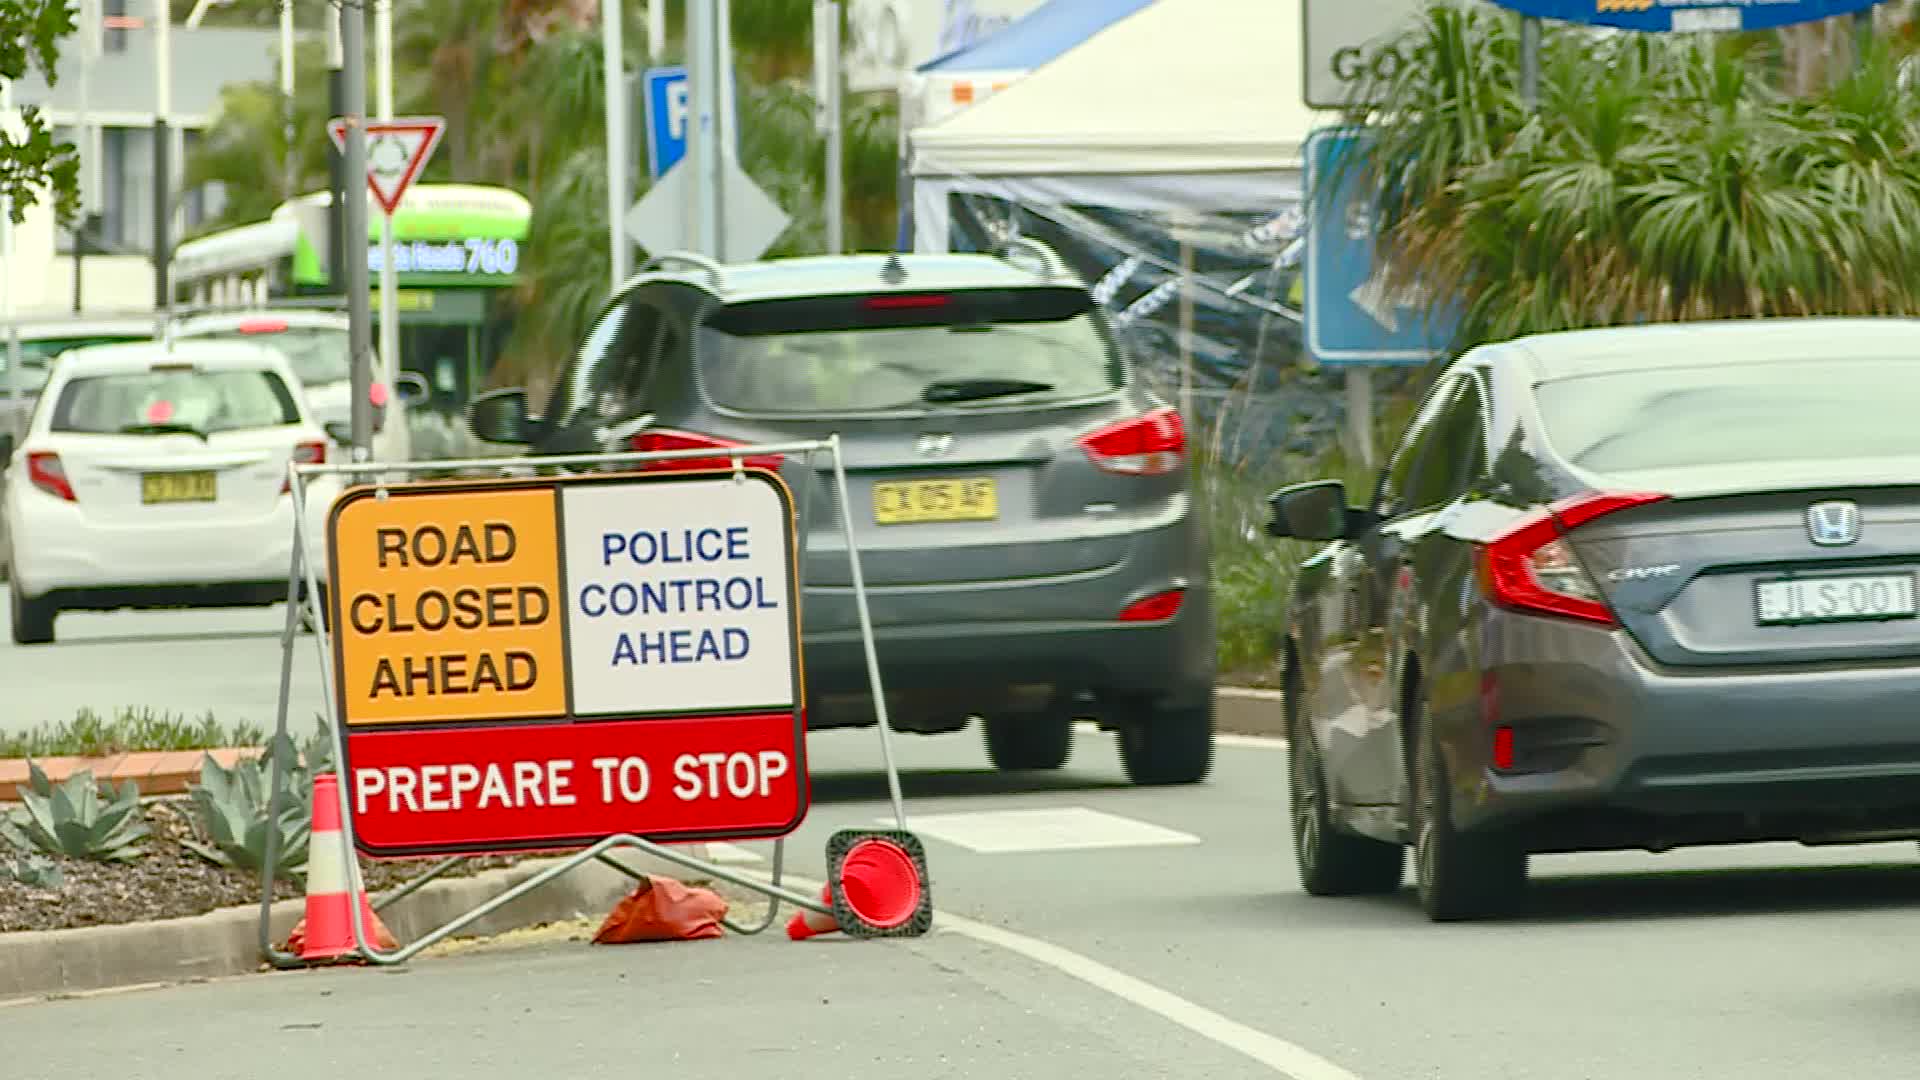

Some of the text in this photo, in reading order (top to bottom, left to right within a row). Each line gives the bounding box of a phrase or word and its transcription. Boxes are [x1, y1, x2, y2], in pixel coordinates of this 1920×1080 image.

[464, 238, 518, 274] 760
[878, 480, 993, 514] CX 05 AF
[377, 523, 516, 567] ROAD
[603, 527, 750, 566] POLICE
[350, 586, 549, 634] CLOSED
[580, 577, 778, 617] CONTROL
[611, 628, 750, 666] AHEAD
[369, 651, 537, 698] AHEAD
[356, 751, 788, 814] PREPARE TO STOP
